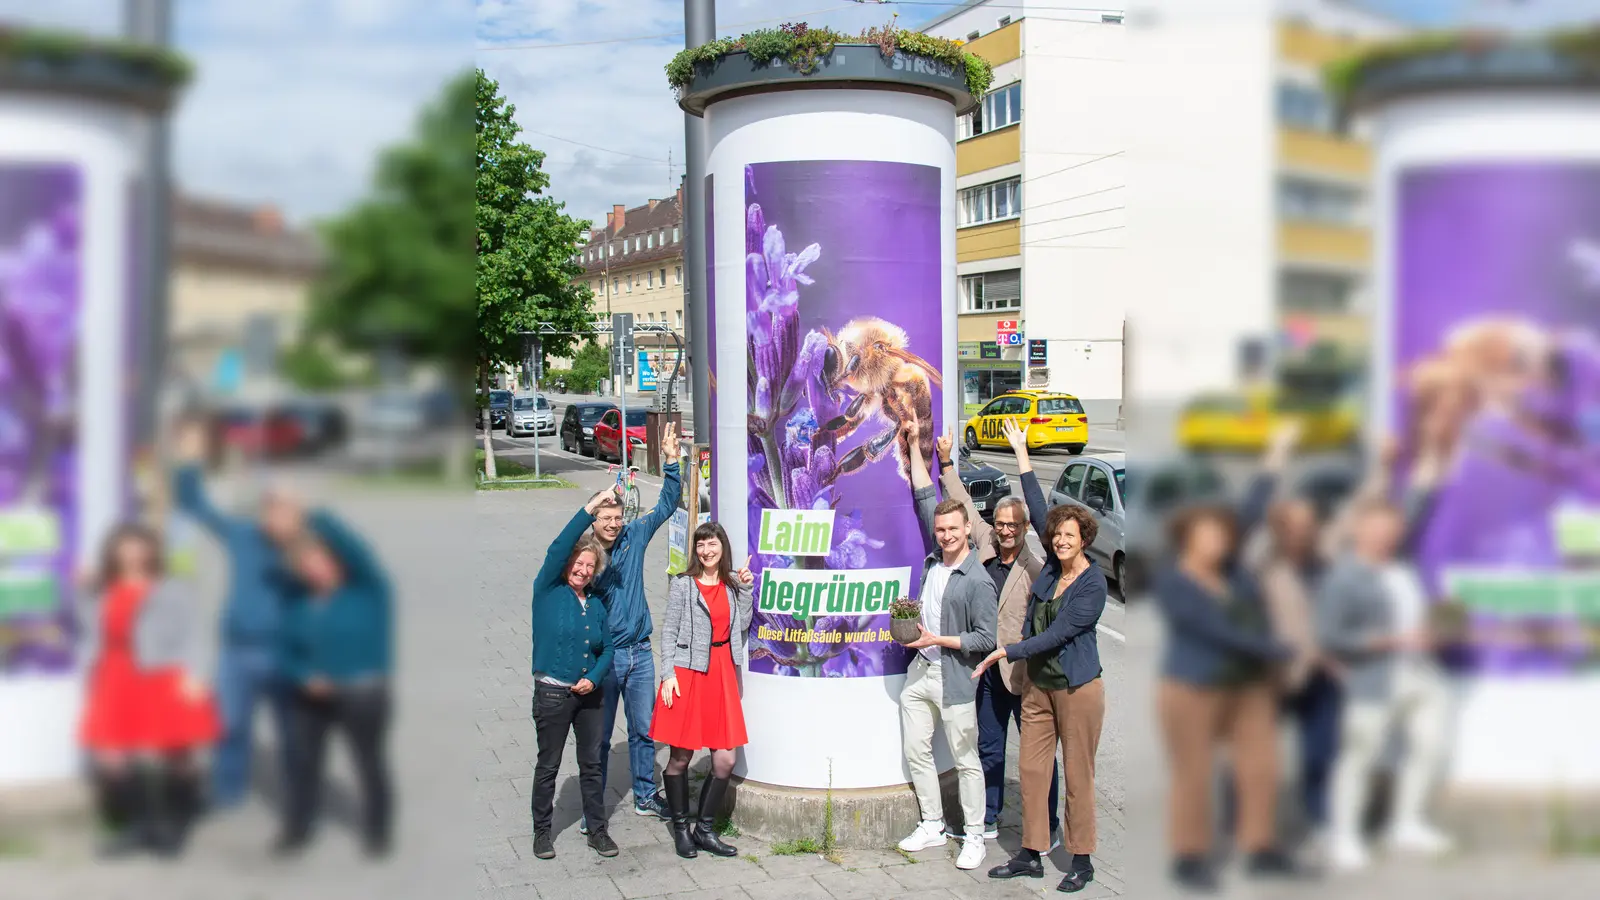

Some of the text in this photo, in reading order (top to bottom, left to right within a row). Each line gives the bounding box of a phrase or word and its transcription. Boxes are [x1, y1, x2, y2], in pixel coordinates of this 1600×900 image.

[982, 419, 1006, 439] ADA
[760, 511, 831, 553] Laim
[760, 570, 900, 620] begrünen
[758, 625, 782, 641] Diese
[784, 627, 843, 644] Litfaßsäule
[844, 628, 877, 643] wurde
